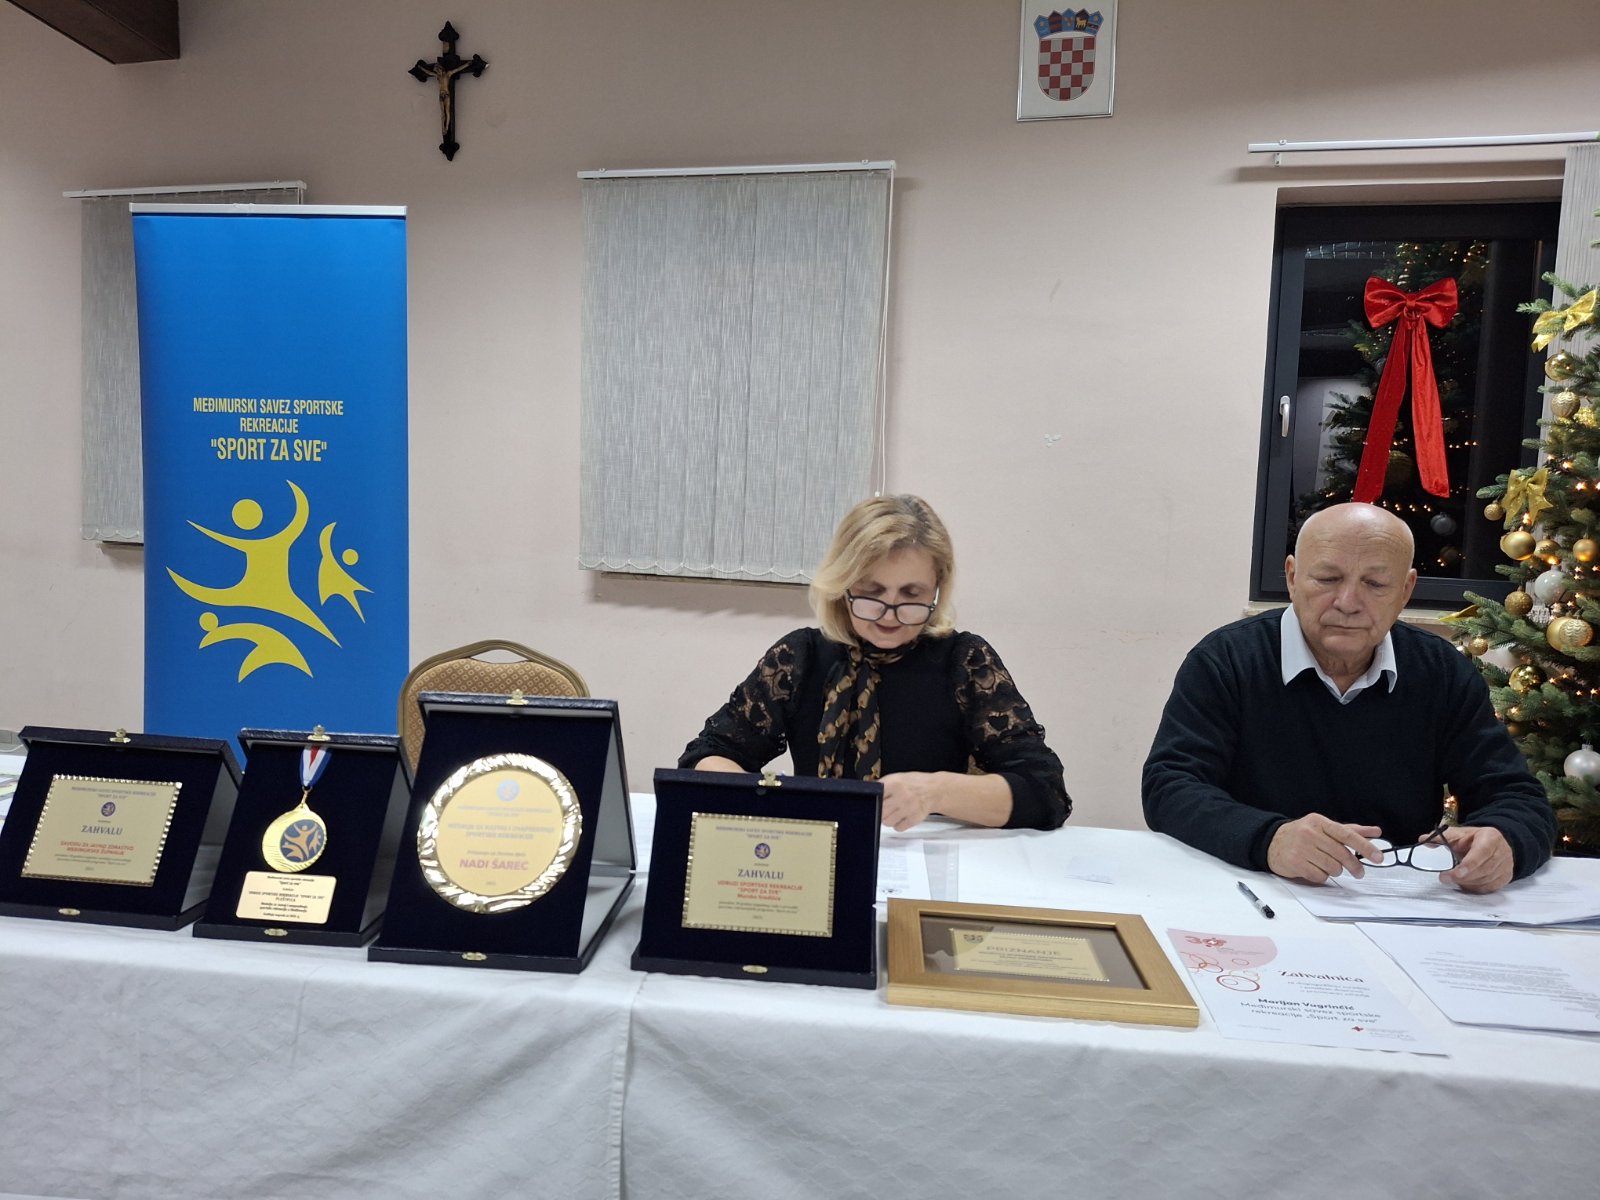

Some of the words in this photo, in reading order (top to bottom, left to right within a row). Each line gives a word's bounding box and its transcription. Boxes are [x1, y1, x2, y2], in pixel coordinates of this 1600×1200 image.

[193, 397, 257, 413] MEĐIMURSKI
[260, 399, 291, 414] SAVEZ
[293, 400, 344, 416] SPORTSKE
[240, 417, 299, 433] REKREACIJE
[211, 437, 266, 460] "SPORT
[270, 439, 289, 461] ZA
[293, 439, 328, 462] SVE"
[81, 824, 124, 836] ZAHVALU
[459, 859, 489, 869] NADI
[491, 857, 529, 871] ŠAREC
[737, 868, 784, 880] ZAHVALU
[1278, 970, 1365, 983] Zahvalnica
[1258, 998, 1301, 1007] Marijan
